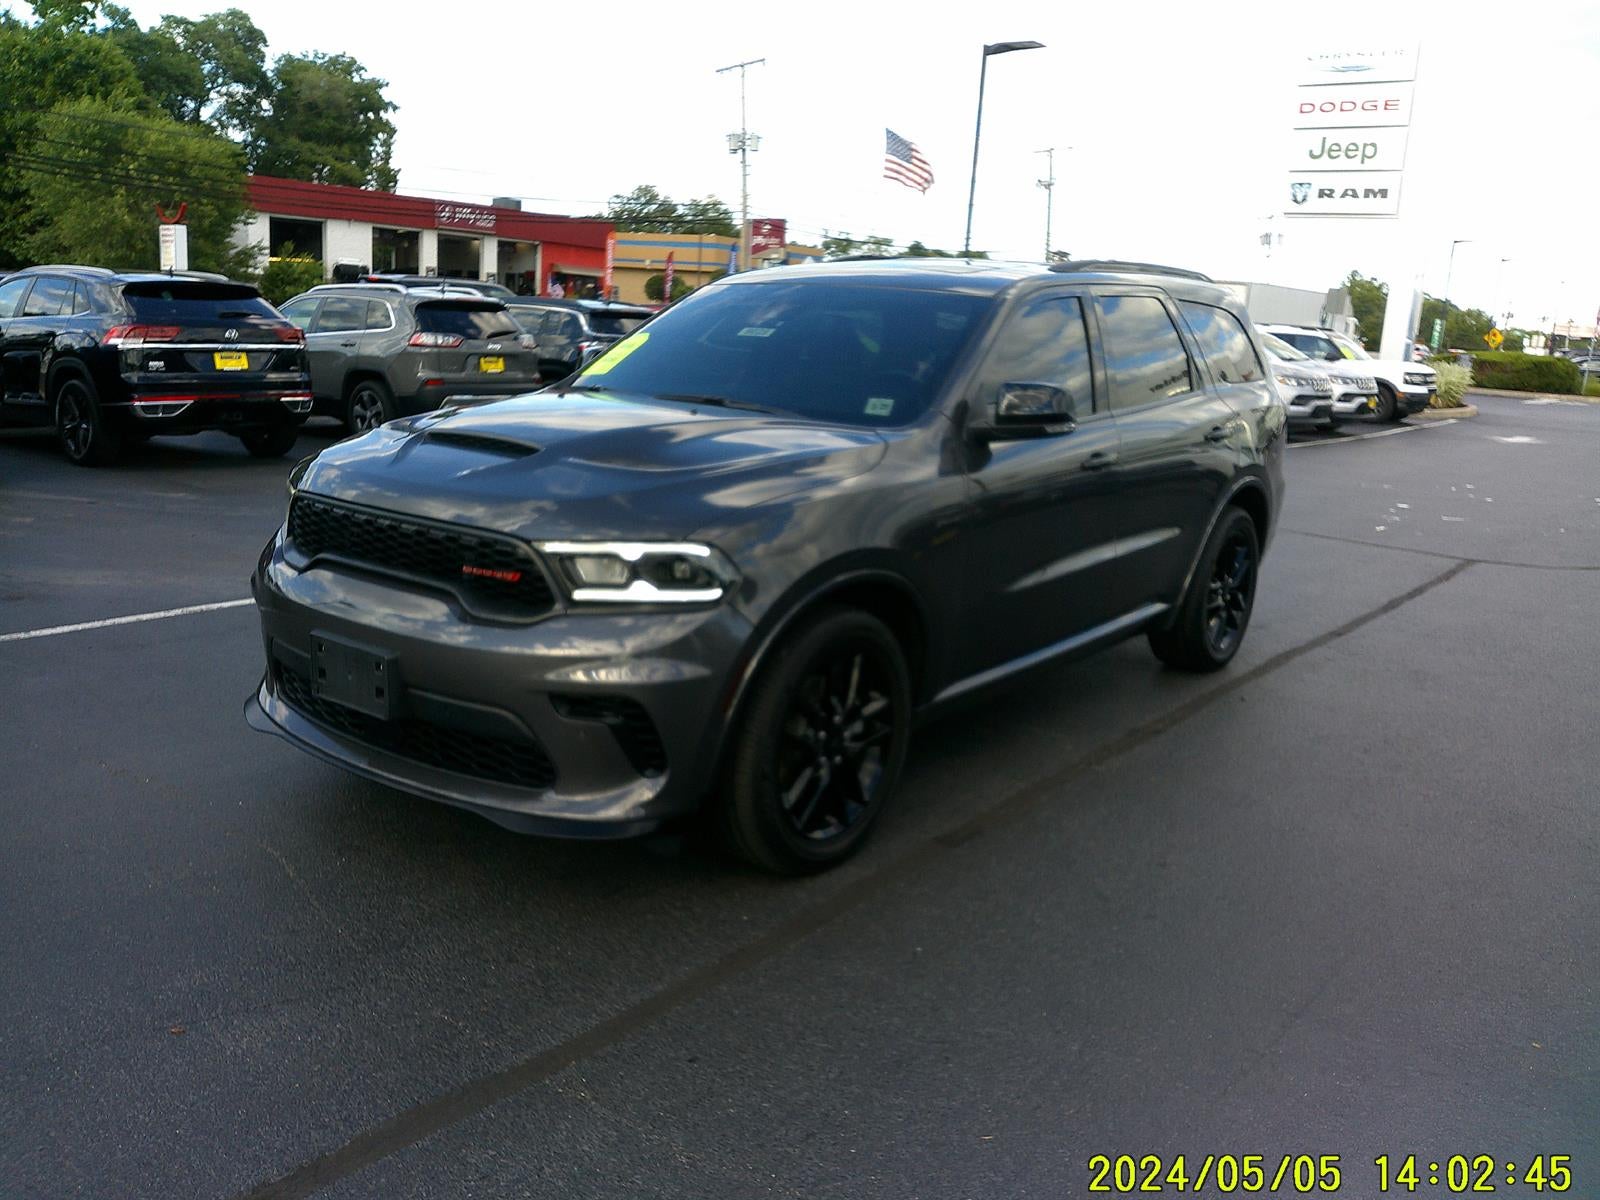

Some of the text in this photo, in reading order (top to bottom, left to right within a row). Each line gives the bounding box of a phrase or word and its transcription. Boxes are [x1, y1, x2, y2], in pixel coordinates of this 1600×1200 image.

[1298, 99, 1401, 114] DODGE
[1308, 136, 1378, 165] Jeep
[1317, 188, 1389, 199] RAM
